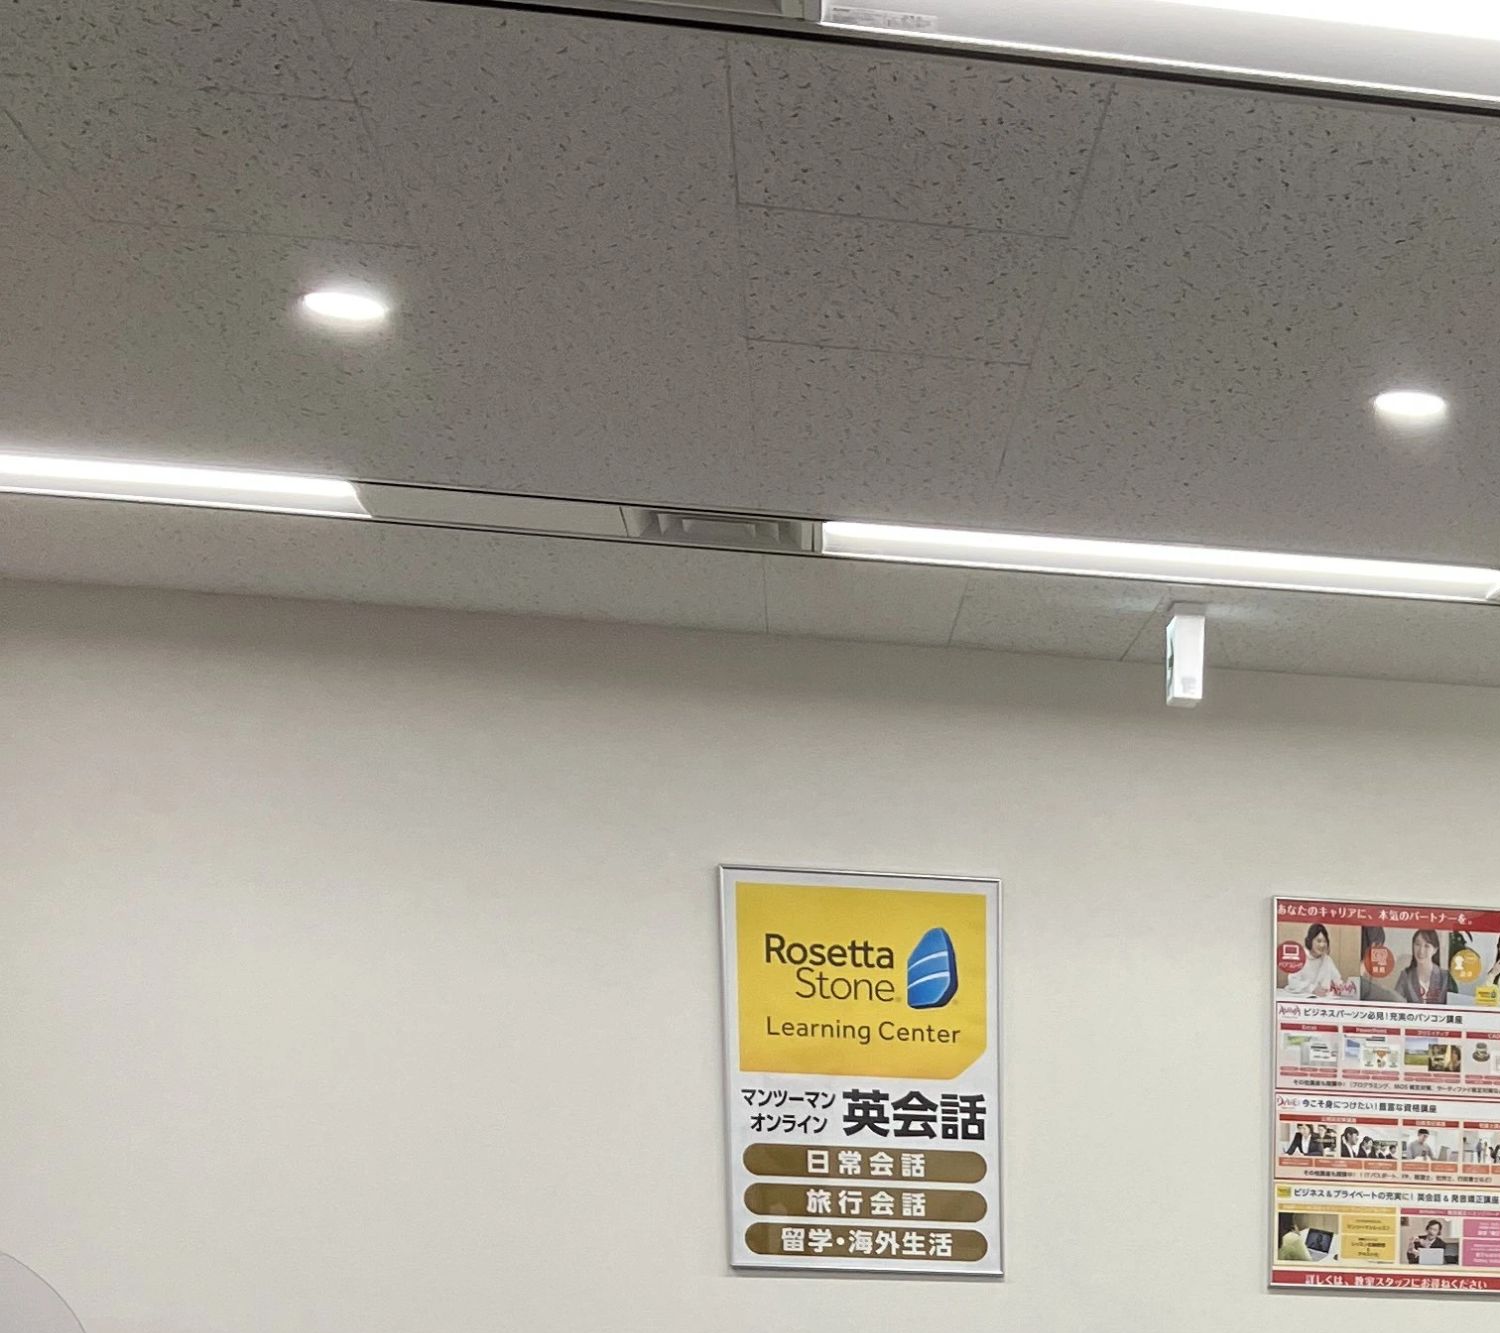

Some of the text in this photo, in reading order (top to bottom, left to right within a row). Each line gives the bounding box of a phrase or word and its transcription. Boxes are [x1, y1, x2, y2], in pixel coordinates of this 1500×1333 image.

[765, 933, 895, 969] Rosetta
[795, 967, 895, 1003] Stone
[766, 1016, 961, 1045] Learning Center
[740, 1088, 987, 1141] マンツーマン 英会話
[749, 1113, 828, 1134] オンライン
[806, 1149, 926, 1178] 日常会話
[805, 1188, 927, 1218] 旅行会話
[780, 1226, 953, 1258] 留学・海外生活
